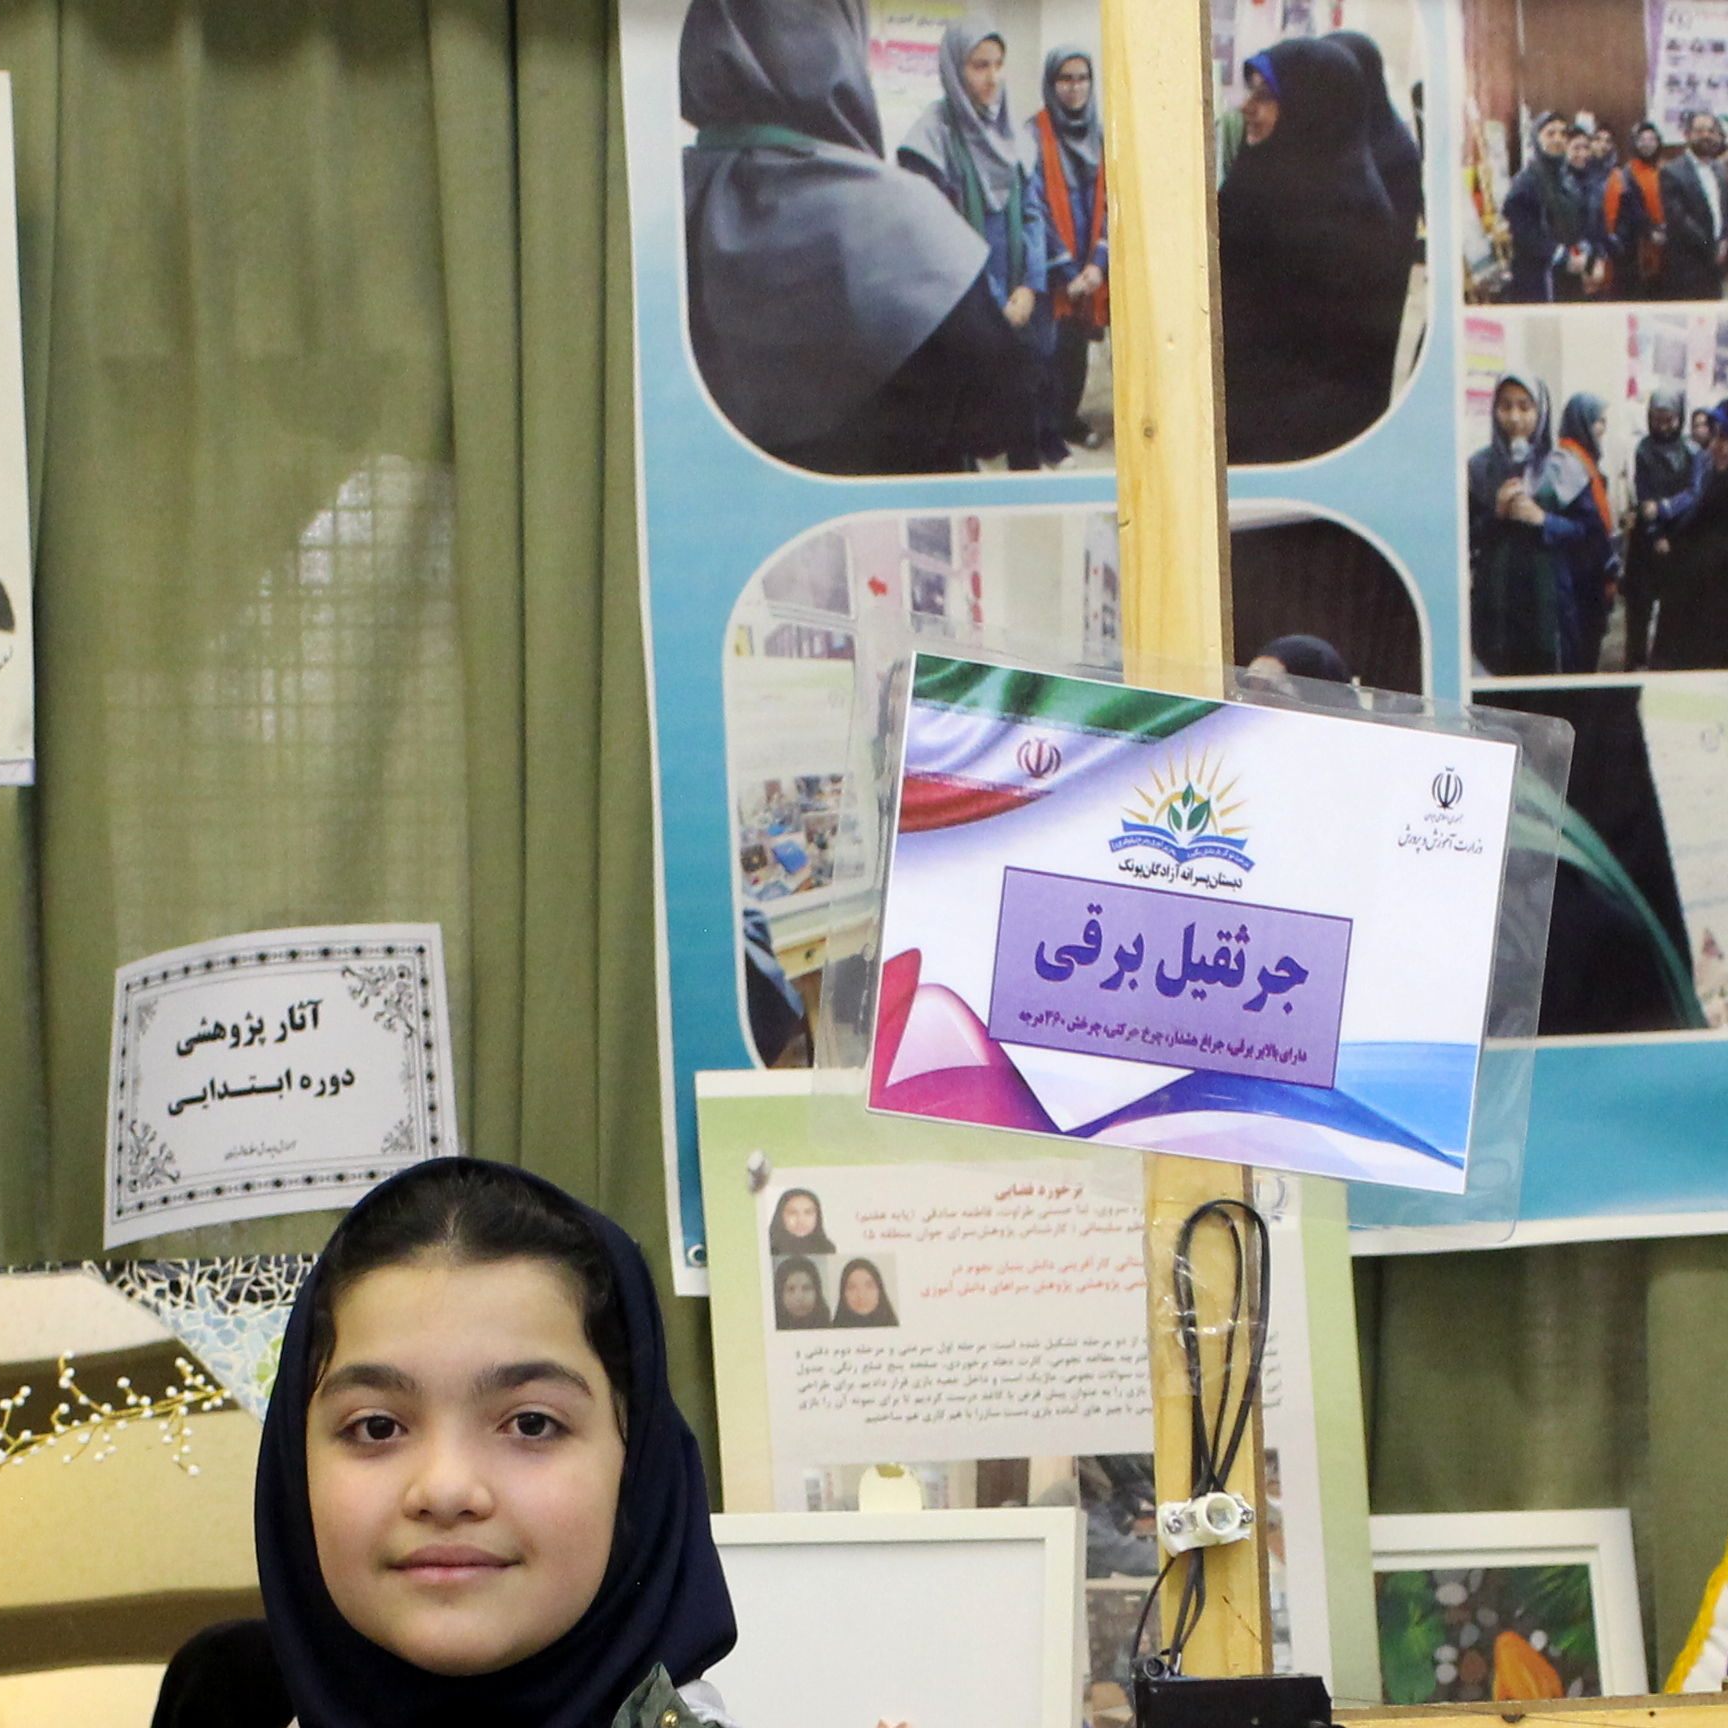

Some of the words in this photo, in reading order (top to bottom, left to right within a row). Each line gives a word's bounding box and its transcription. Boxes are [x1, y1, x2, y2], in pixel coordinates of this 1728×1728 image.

[1209, 872, 1243, 892] دبستان
[1035, 903, 1144, 991] برقی
[1155, 922, 1309, 1015] جرثقیل
[177, 1013, 266, 1057] پژوهشی
[275, 1000, 321, 1043] آثار
[168, 1069, 292, 1116] ابتدایی
[300, 1069, 355, 1097] دوره
